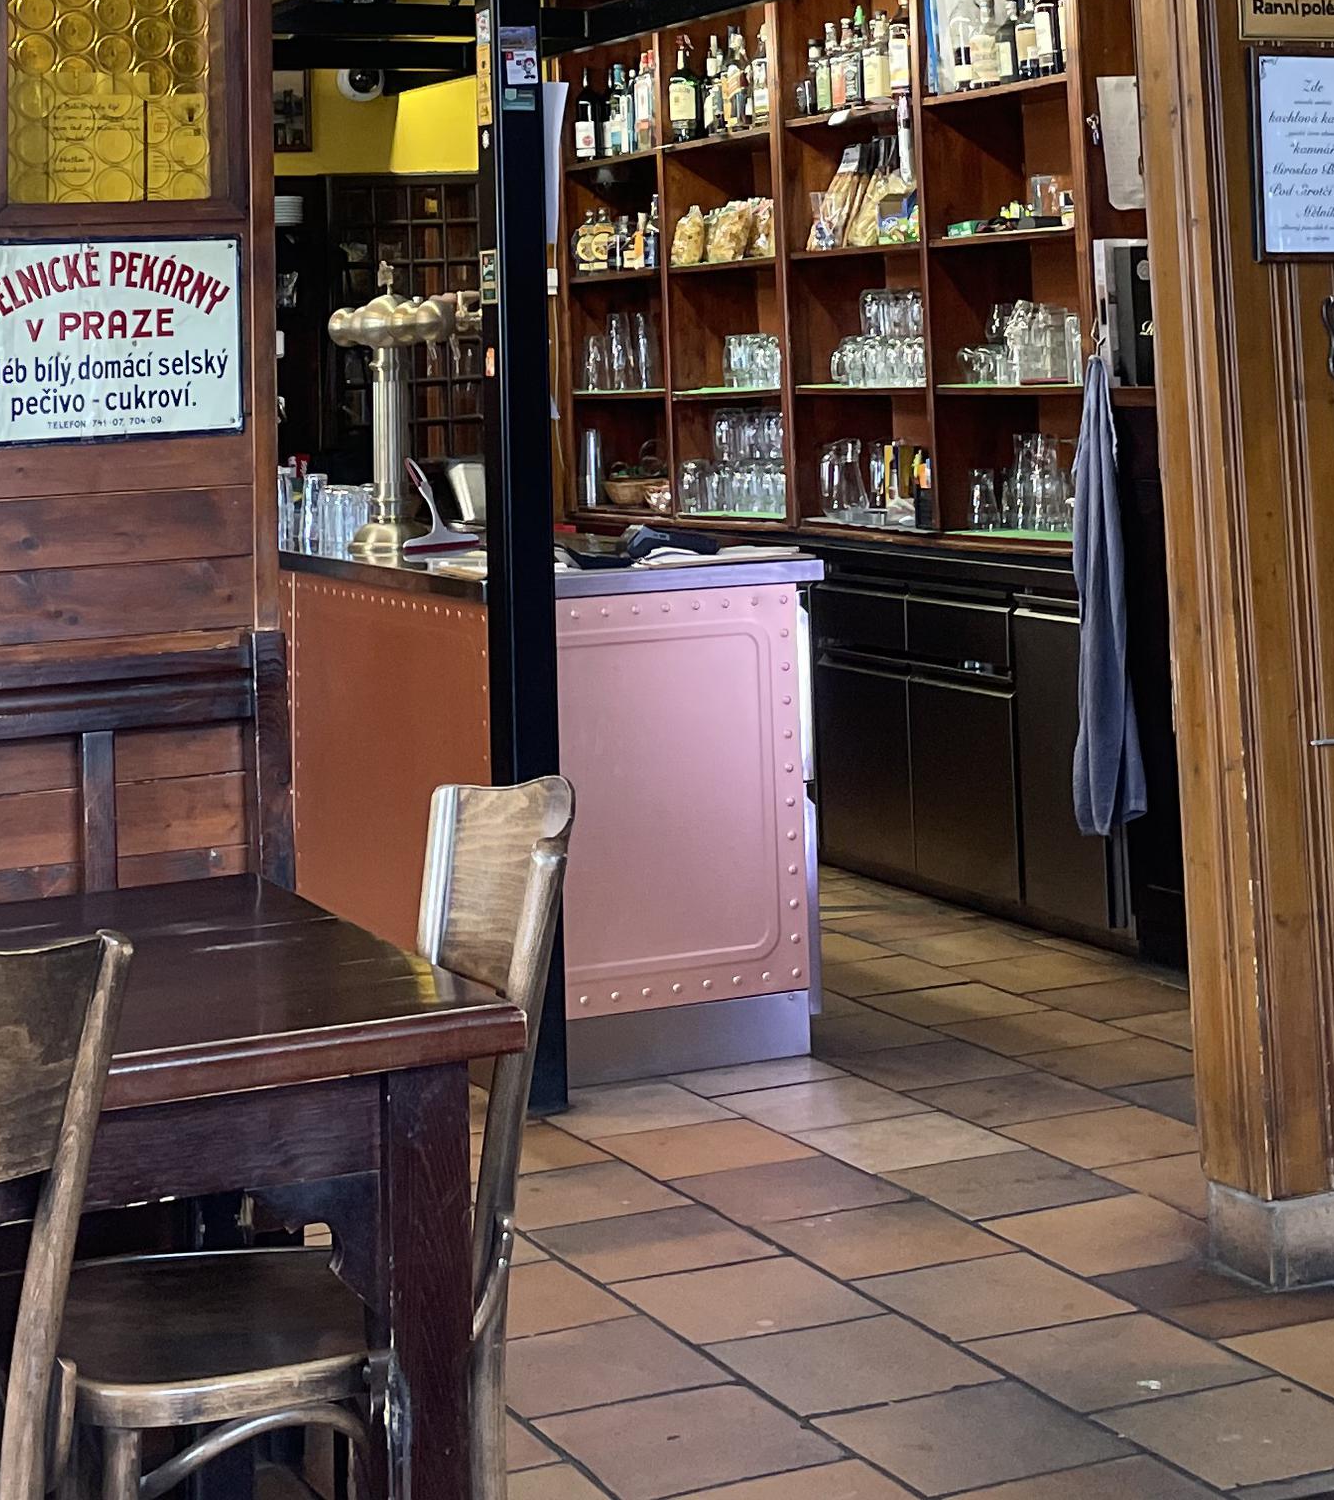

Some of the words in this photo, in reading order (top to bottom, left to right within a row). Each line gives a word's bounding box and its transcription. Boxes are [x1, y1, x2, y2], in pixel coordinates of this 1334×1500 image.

[1302, 79, 1324, 93] Zde
[109, 250, 231, 315] PEKÁRNY
[58, 307, 175, 341] PRAZE
[33, 351, 76, 387] bílý,
[78, 351, 153, 381] domácí
[157, 348, 229, 379] selský
[10, 387, 86, 422] pečivo
[105, 381, 198, 411] cukroví.
[46, 420, 87, 430] TELEFON
